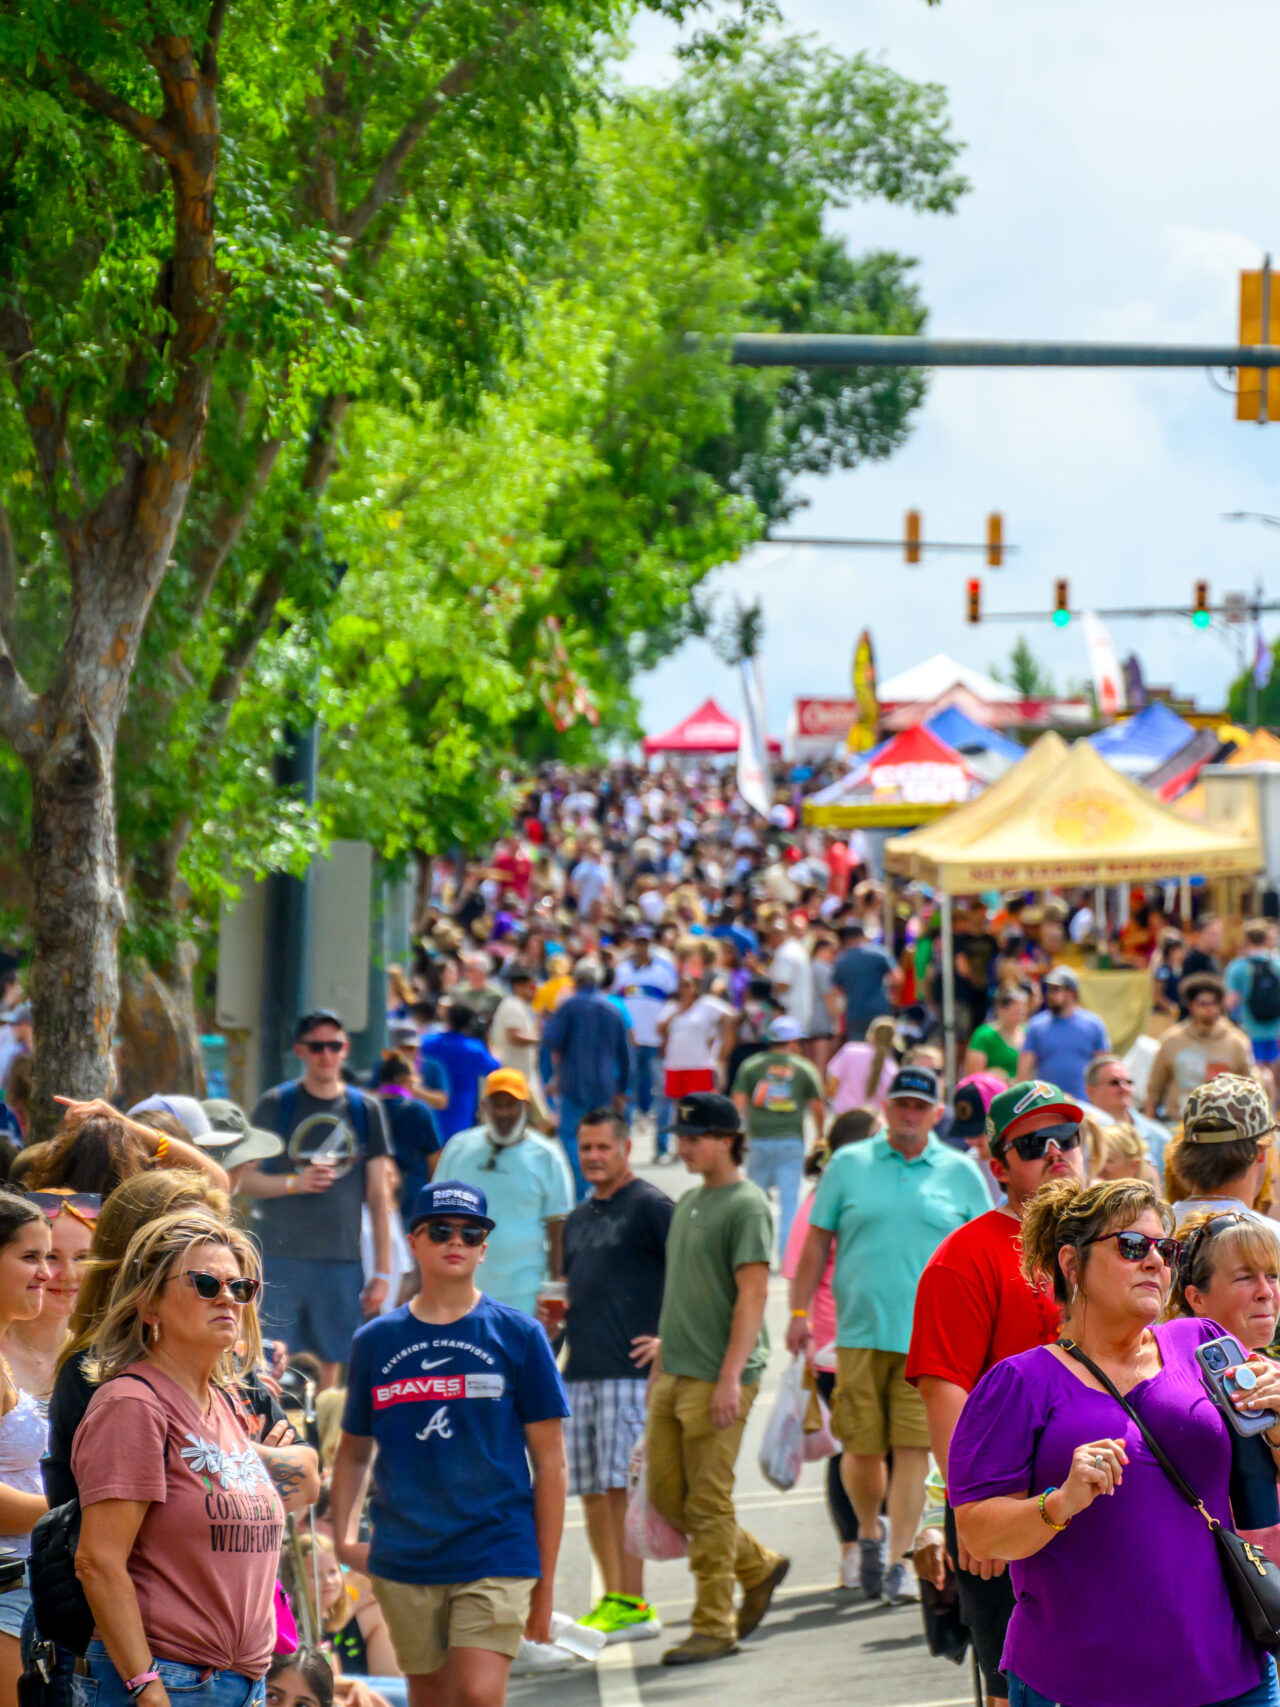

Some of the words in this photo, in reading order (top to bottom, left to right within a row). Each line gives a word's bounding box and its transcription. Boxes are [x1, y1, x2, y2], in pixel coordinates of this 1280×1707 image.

[968, 865, 1017, 882] NEW
[433, 1189, 479, 1205] RIPKEN
[433, 1198, 478, 1212] BASEBALL
[381, 1341, 428, 1375] DIVISION
[432, 1339, 496, 1366] CHAMPIONS
[376, 1378, 460, 1402] BRAVES
[443, 1390, 461, 1398] EAST
